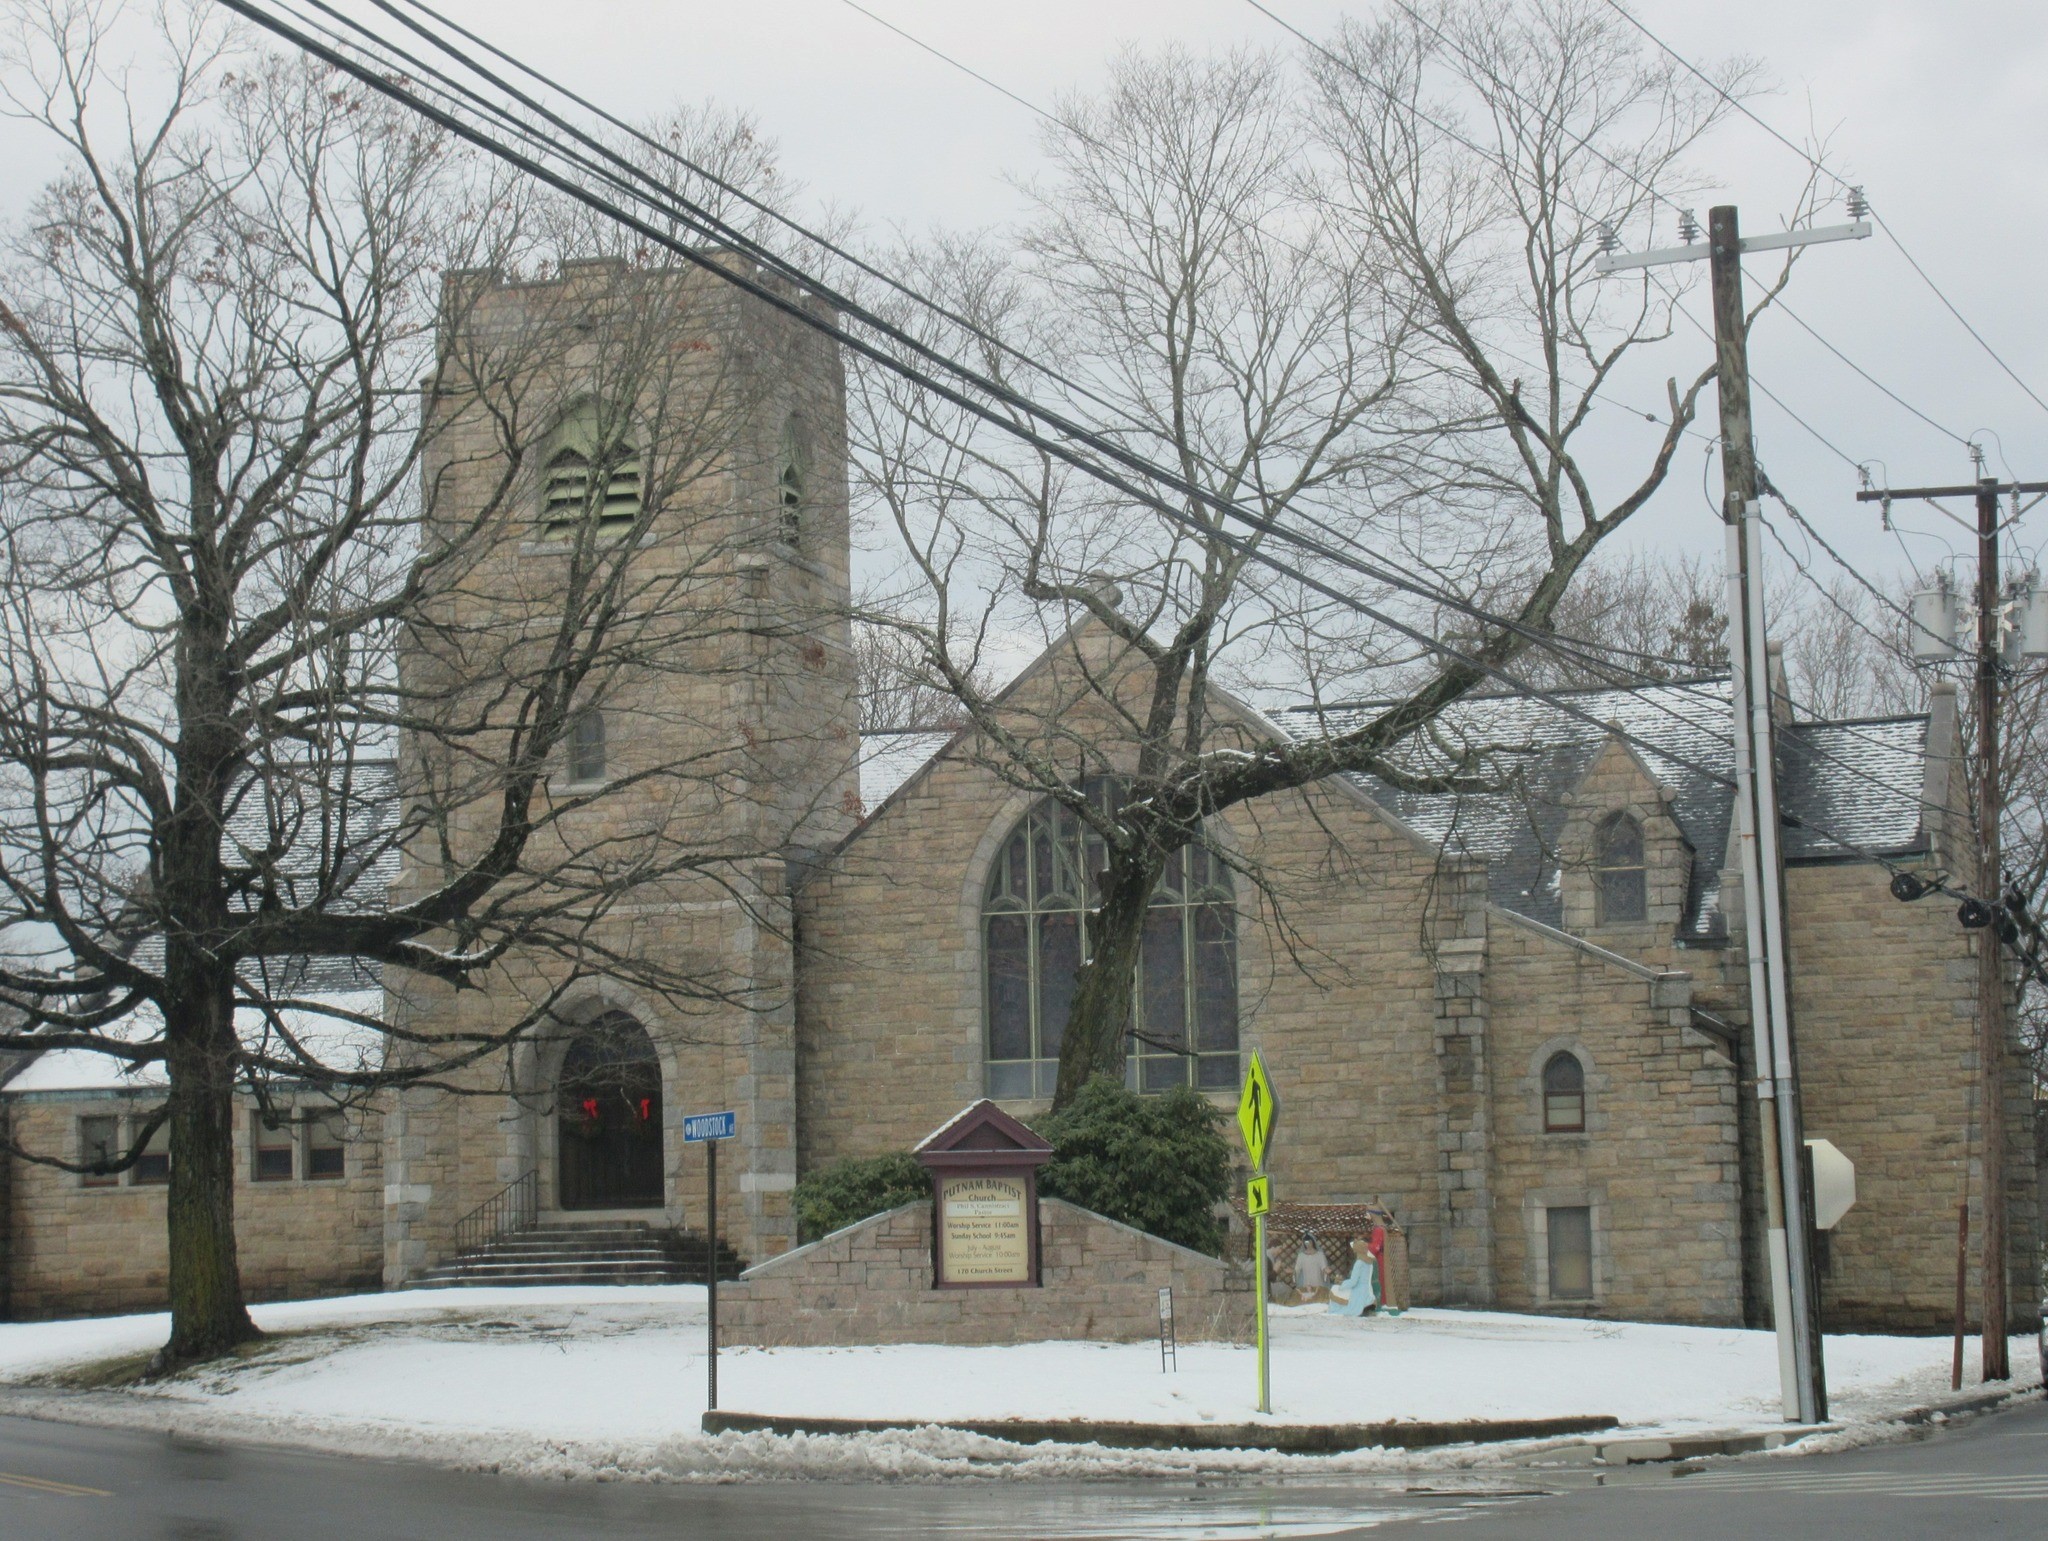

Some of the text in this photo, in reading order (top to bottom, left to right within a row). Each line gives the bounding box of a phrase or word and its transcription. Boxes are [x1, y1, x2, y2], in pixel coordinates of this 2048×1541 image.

[692, 1116, 726, 1138] WOODSTOCK
[943, 1179, 1021, 1200] PUTNAM BAPTIST
[968, 1194, 996, 1202] Church
[947, 1222, 970, 1230] Worship
